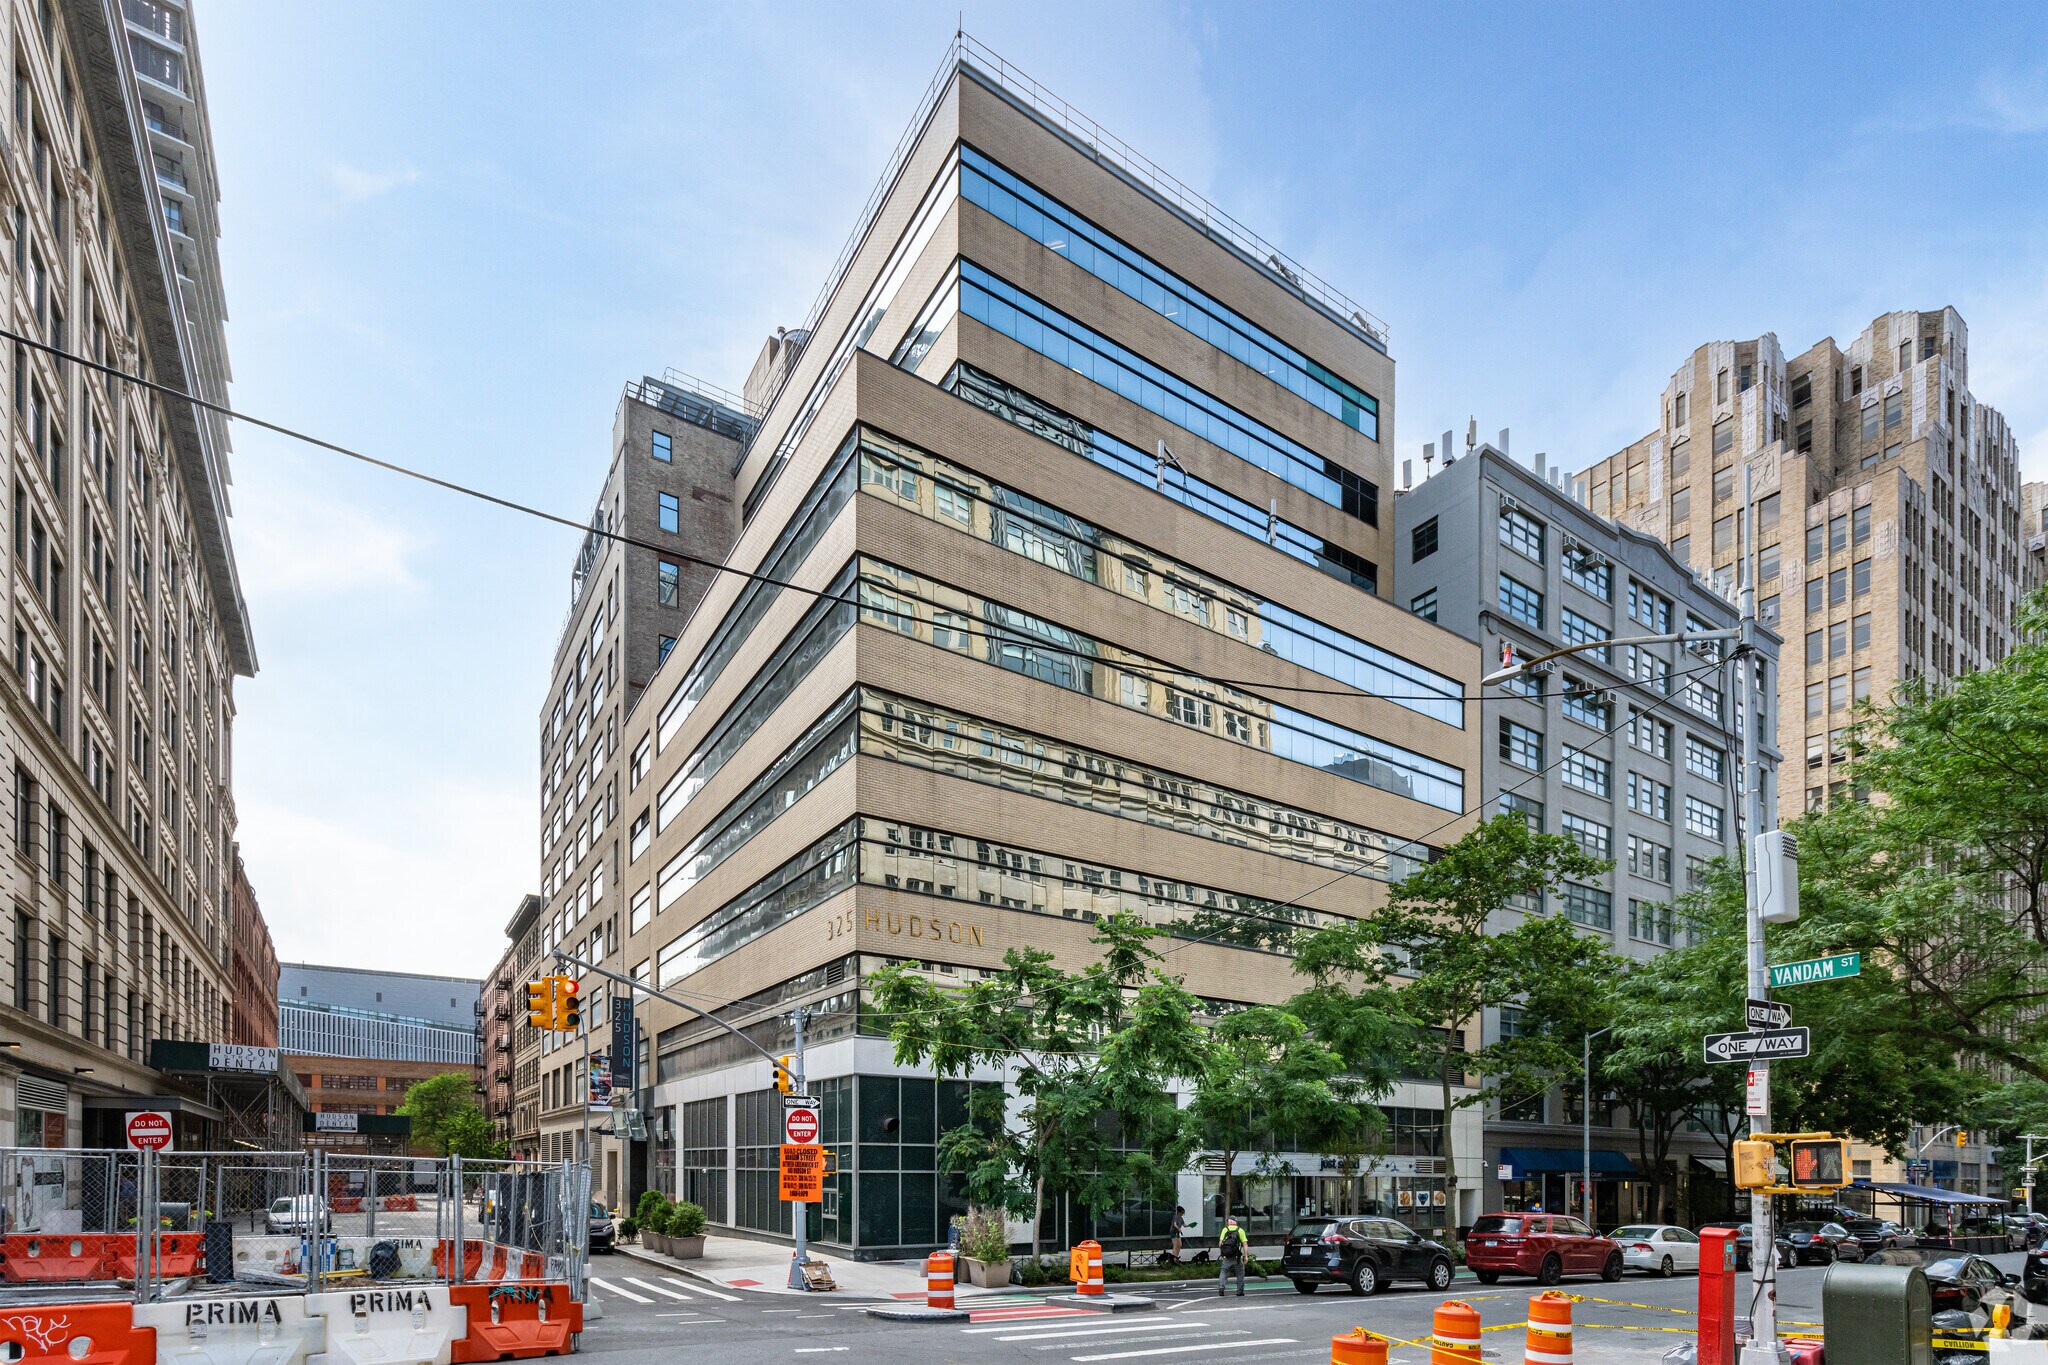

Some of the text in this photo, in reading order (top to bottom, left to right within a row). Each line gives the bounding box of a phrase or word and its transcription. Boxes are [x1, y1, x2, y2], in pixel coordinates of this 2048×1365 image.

[827, 907, 983, 947] 325 HUDSON
[1774, 956, 1854, 985] VANDAM ST
[1750, 1008, 1786, 1023] ONE WAY
[623, 1001, 631, 1068] HUDSON
[213, 1045, 276, 1058] HUDSON
[1718, 1037, 1799, 1054] ONE WAY
[212, 1057, 276, 1070] DENTAL
[1320, 1158, 1337, 1171] just
[392, 1239, 423, 1249] RIMA
[350, 1290, 432, 1314] PRIMA
[185, 1299, 282, 1326] PRIMA
[1433, 1339, 1454, 1348] CAUTION
